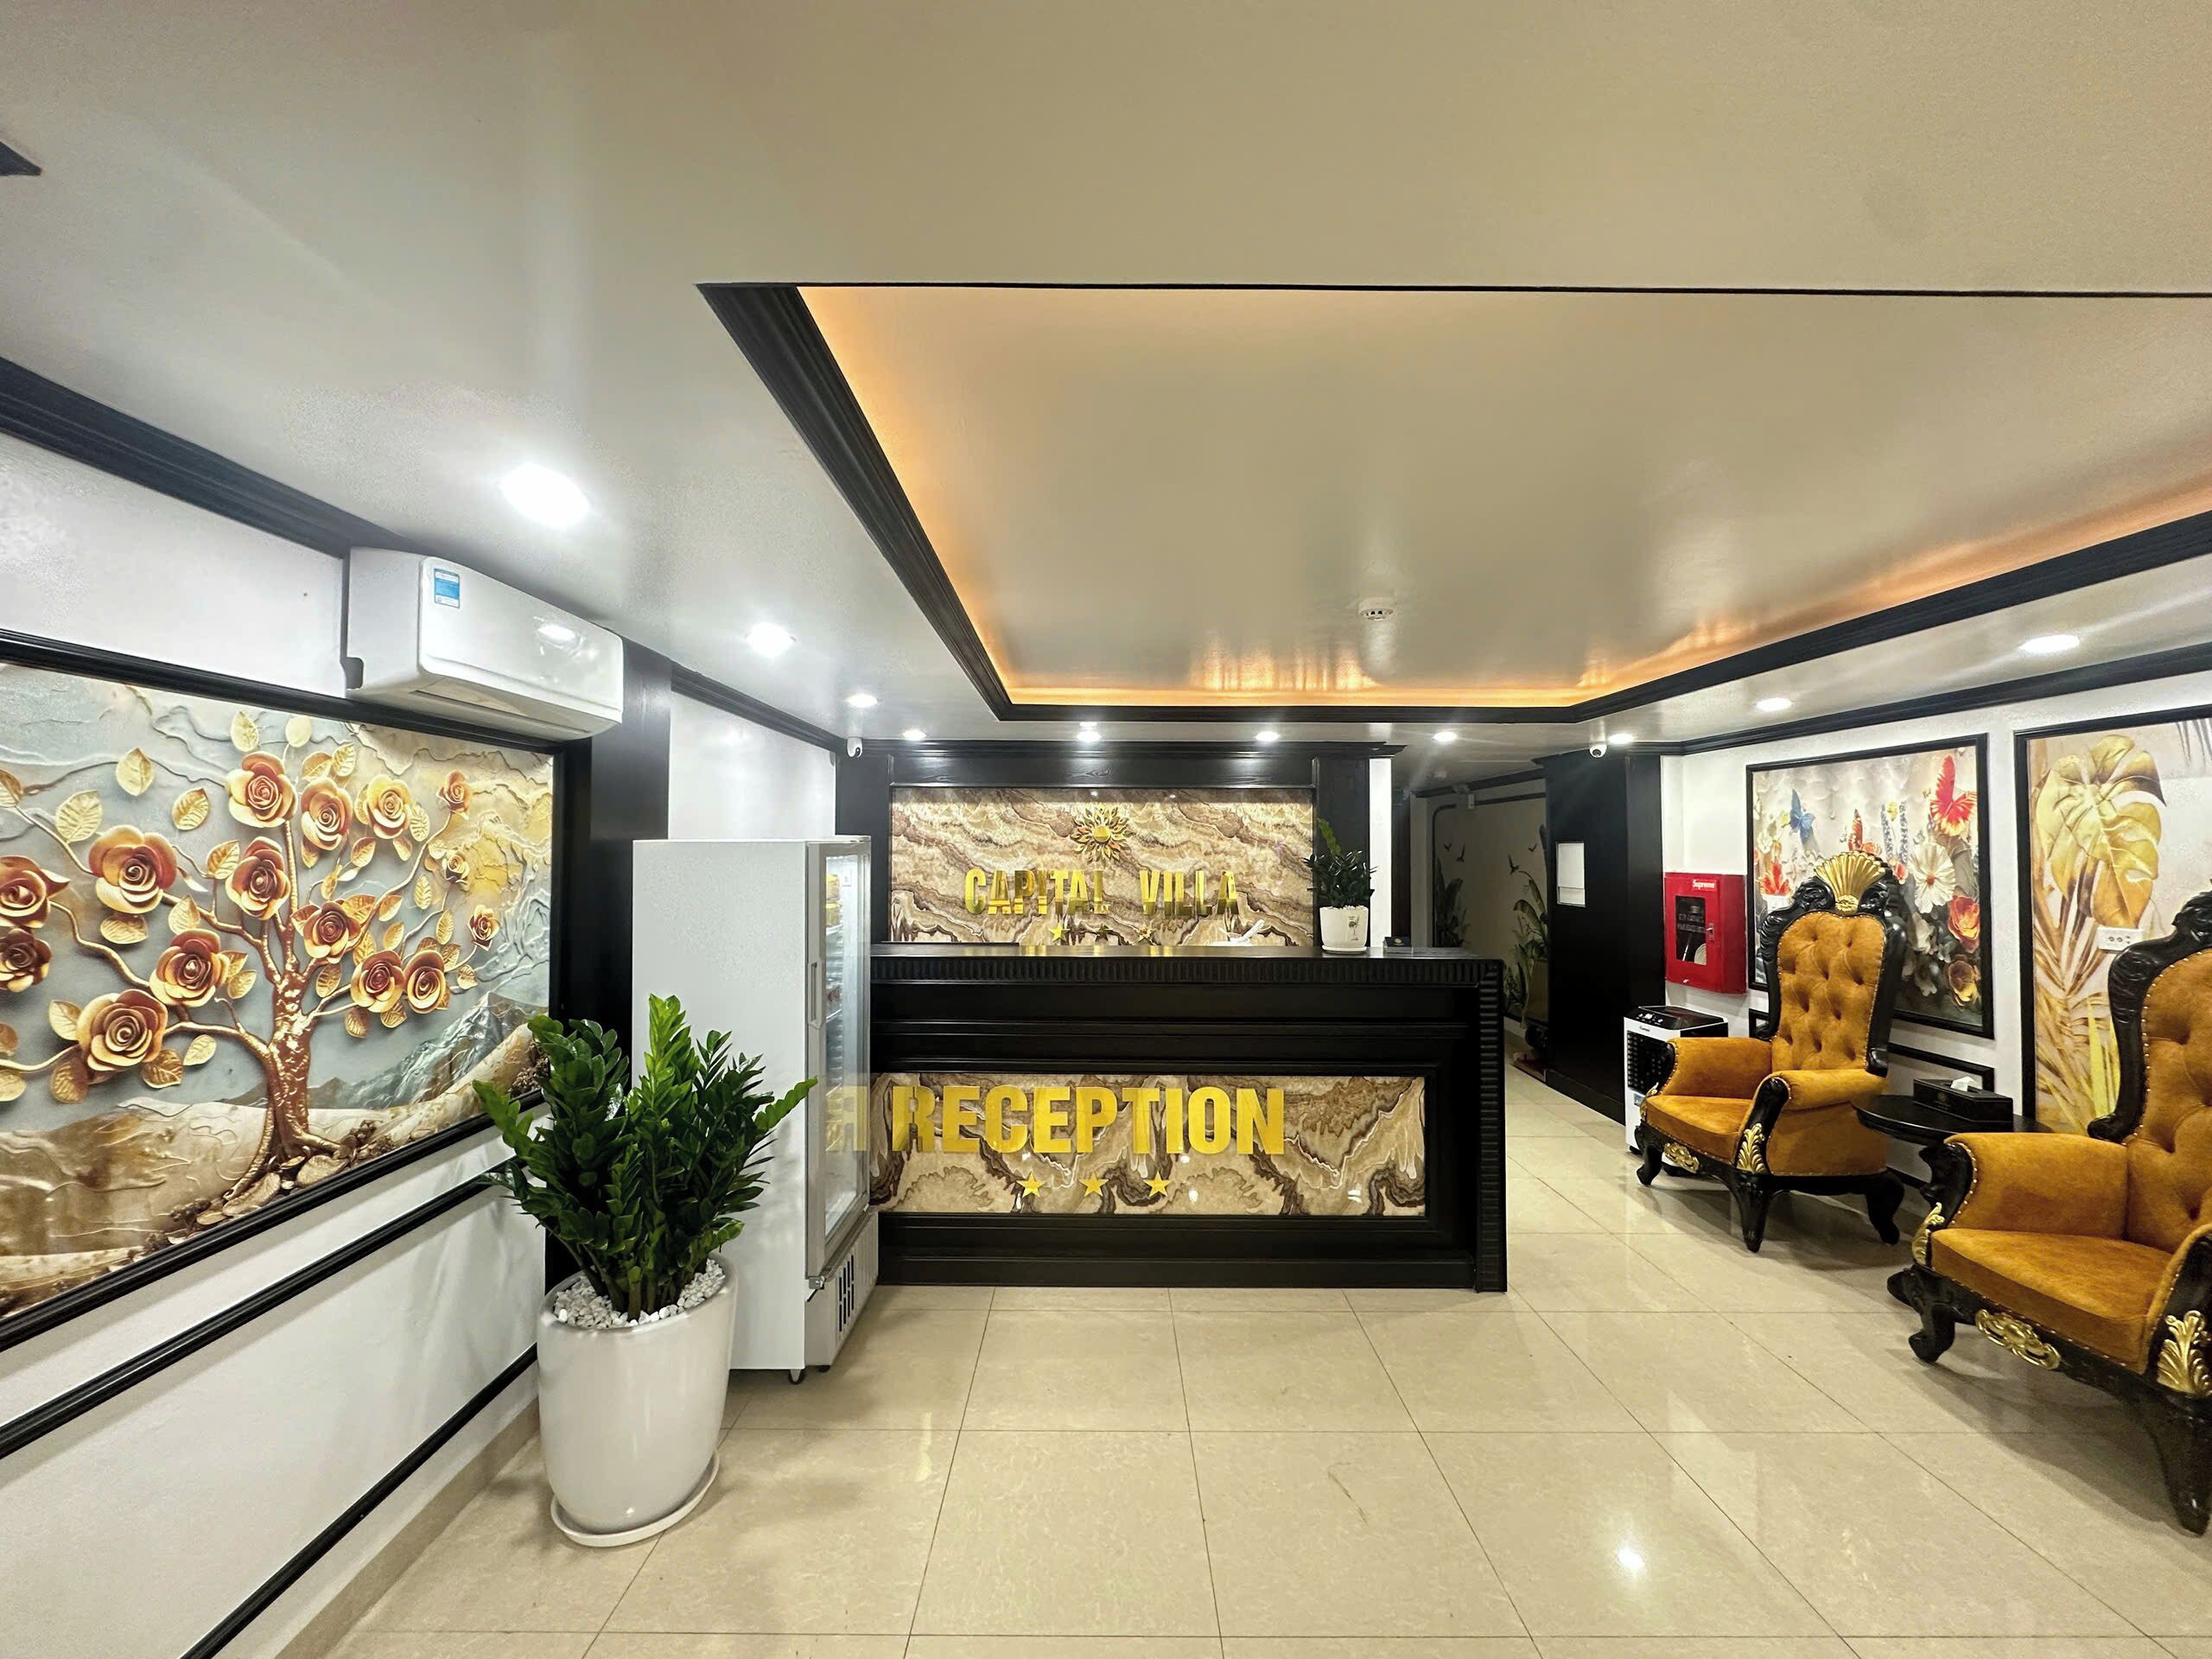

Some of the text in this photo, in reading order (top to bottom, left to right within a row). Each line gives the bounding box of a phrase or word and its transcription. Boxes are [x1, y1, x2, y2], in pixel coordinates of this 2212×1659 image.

[964, 867, 1240, 915] CAPITAL VILLA
[892, 1085, 1285, 1155] RECEPTION
